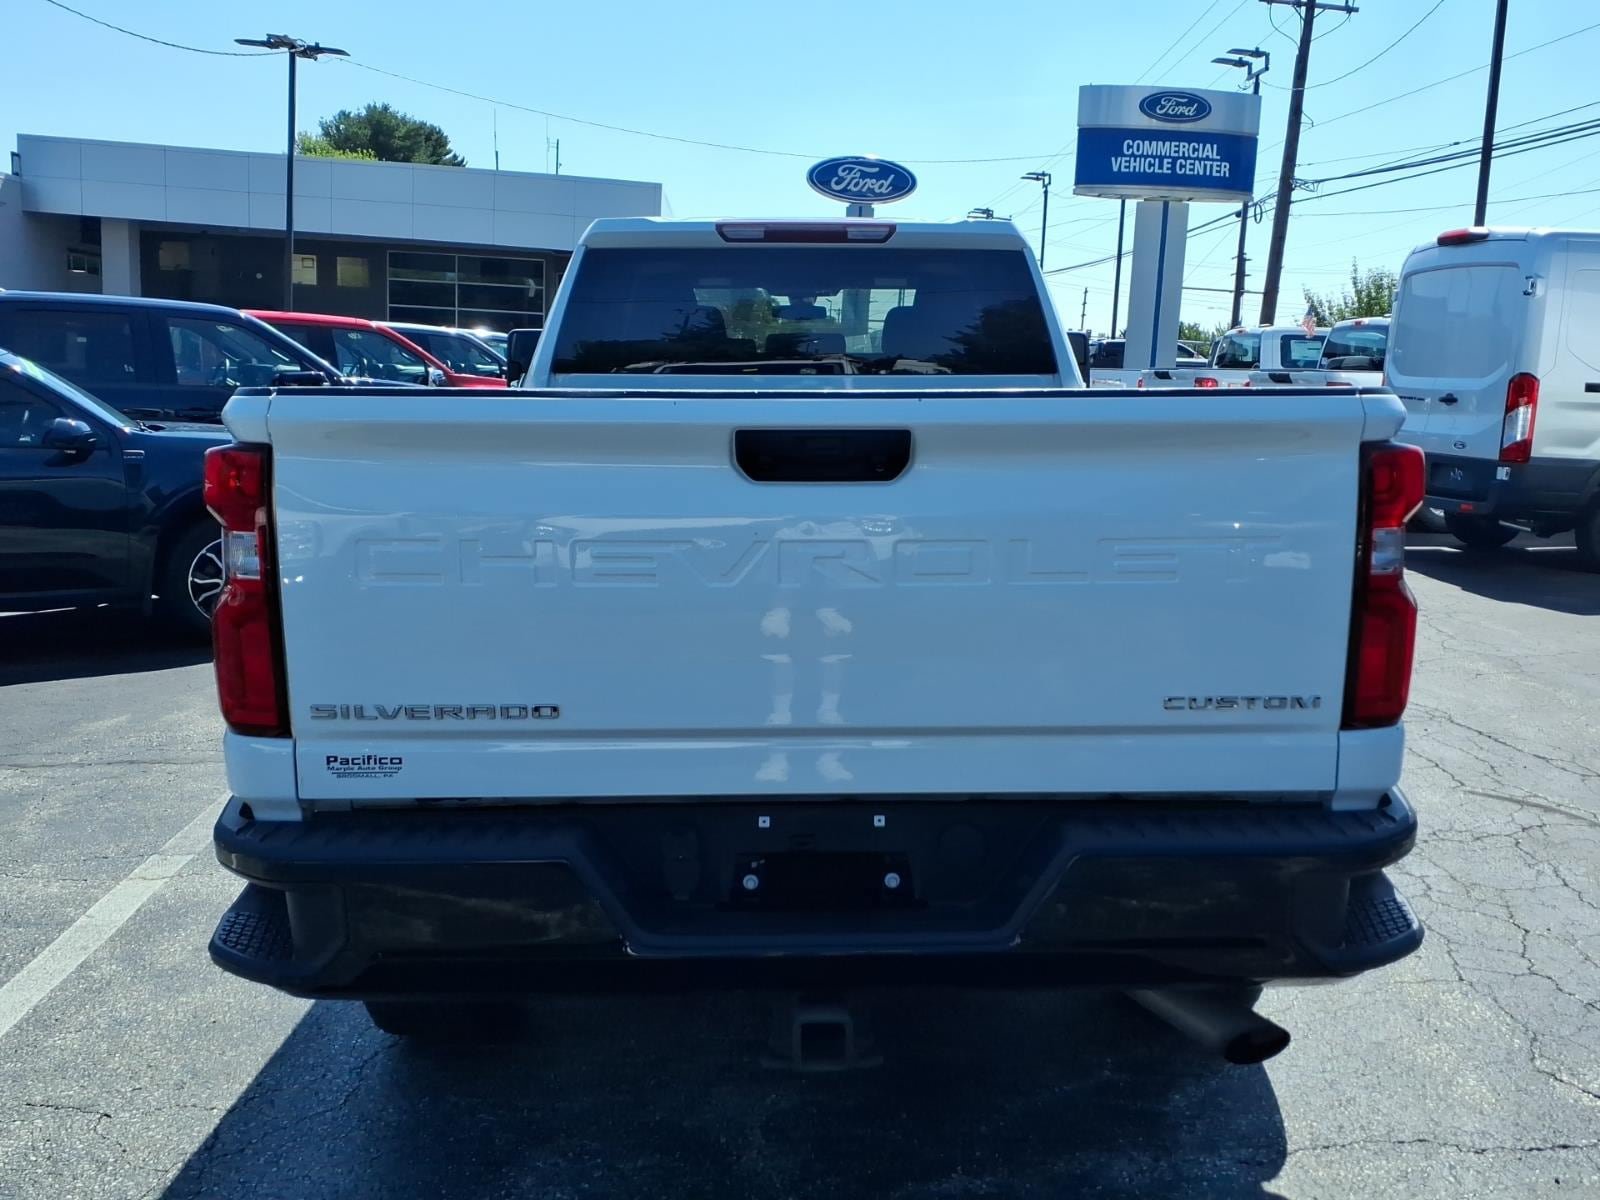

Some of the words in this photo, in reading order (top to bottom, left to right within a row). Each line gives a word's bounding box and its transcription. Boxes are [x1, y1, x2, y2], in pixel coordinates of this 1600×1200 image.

[1155, 96, 1199, 116] Ford
[1123, 139, 1221, 160] COMMERCIAL
[1111, 157, 1172, 174] VEHICLE
[1176, 159, 1230, 177] CENTER
[830, 164, 896, 194] Ford
[354, 537, 1282, 589] CHEVROLET
[310, 703, 561, 721] SILVERADO
[1163, 695, 1322, 710] CUSTOM
[326, 754, 403, 766] Pacifico
